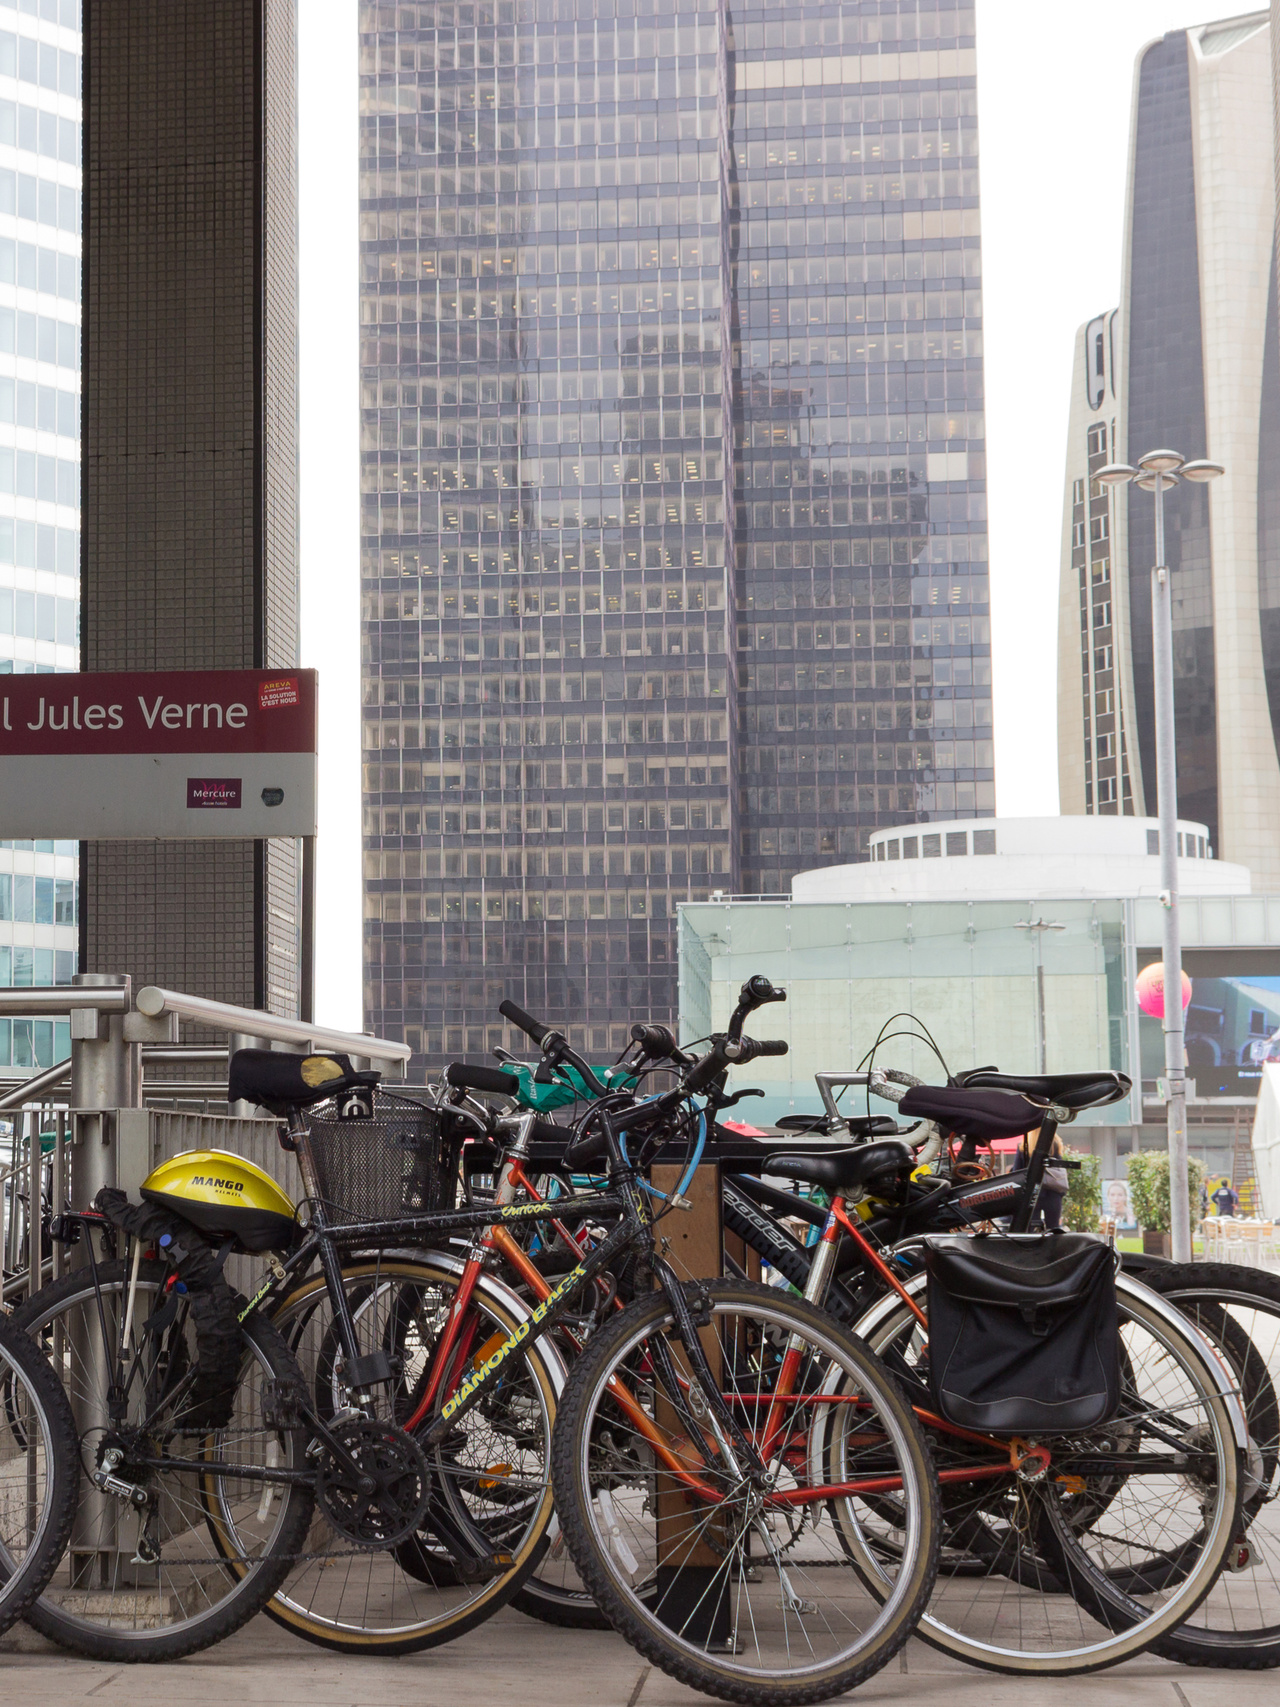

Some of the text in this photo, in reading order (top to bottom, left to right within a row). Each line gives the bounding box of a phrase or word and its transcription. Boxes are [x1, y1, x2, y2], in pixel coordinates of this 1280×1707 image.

[264, 681, 291, 690] AREVA
[261, 697, 297, 707] C'EST NOUS
[269, 691, 297, 700] SOLUTION
[27, 696, 124, 731] Jules
[137, 696, 248, 730] Verne
[193, 790, 236, 798] Mercure
[192, 1176, 244, 1192] MANGO
[960, 1185, 1015, 1209] DOBERMAN
[502, 1202, 552, 1216] Outlook
[723, 1188, 797, 1252] eader
[441, 1262, 587, 1420] DIAMOND BACK
